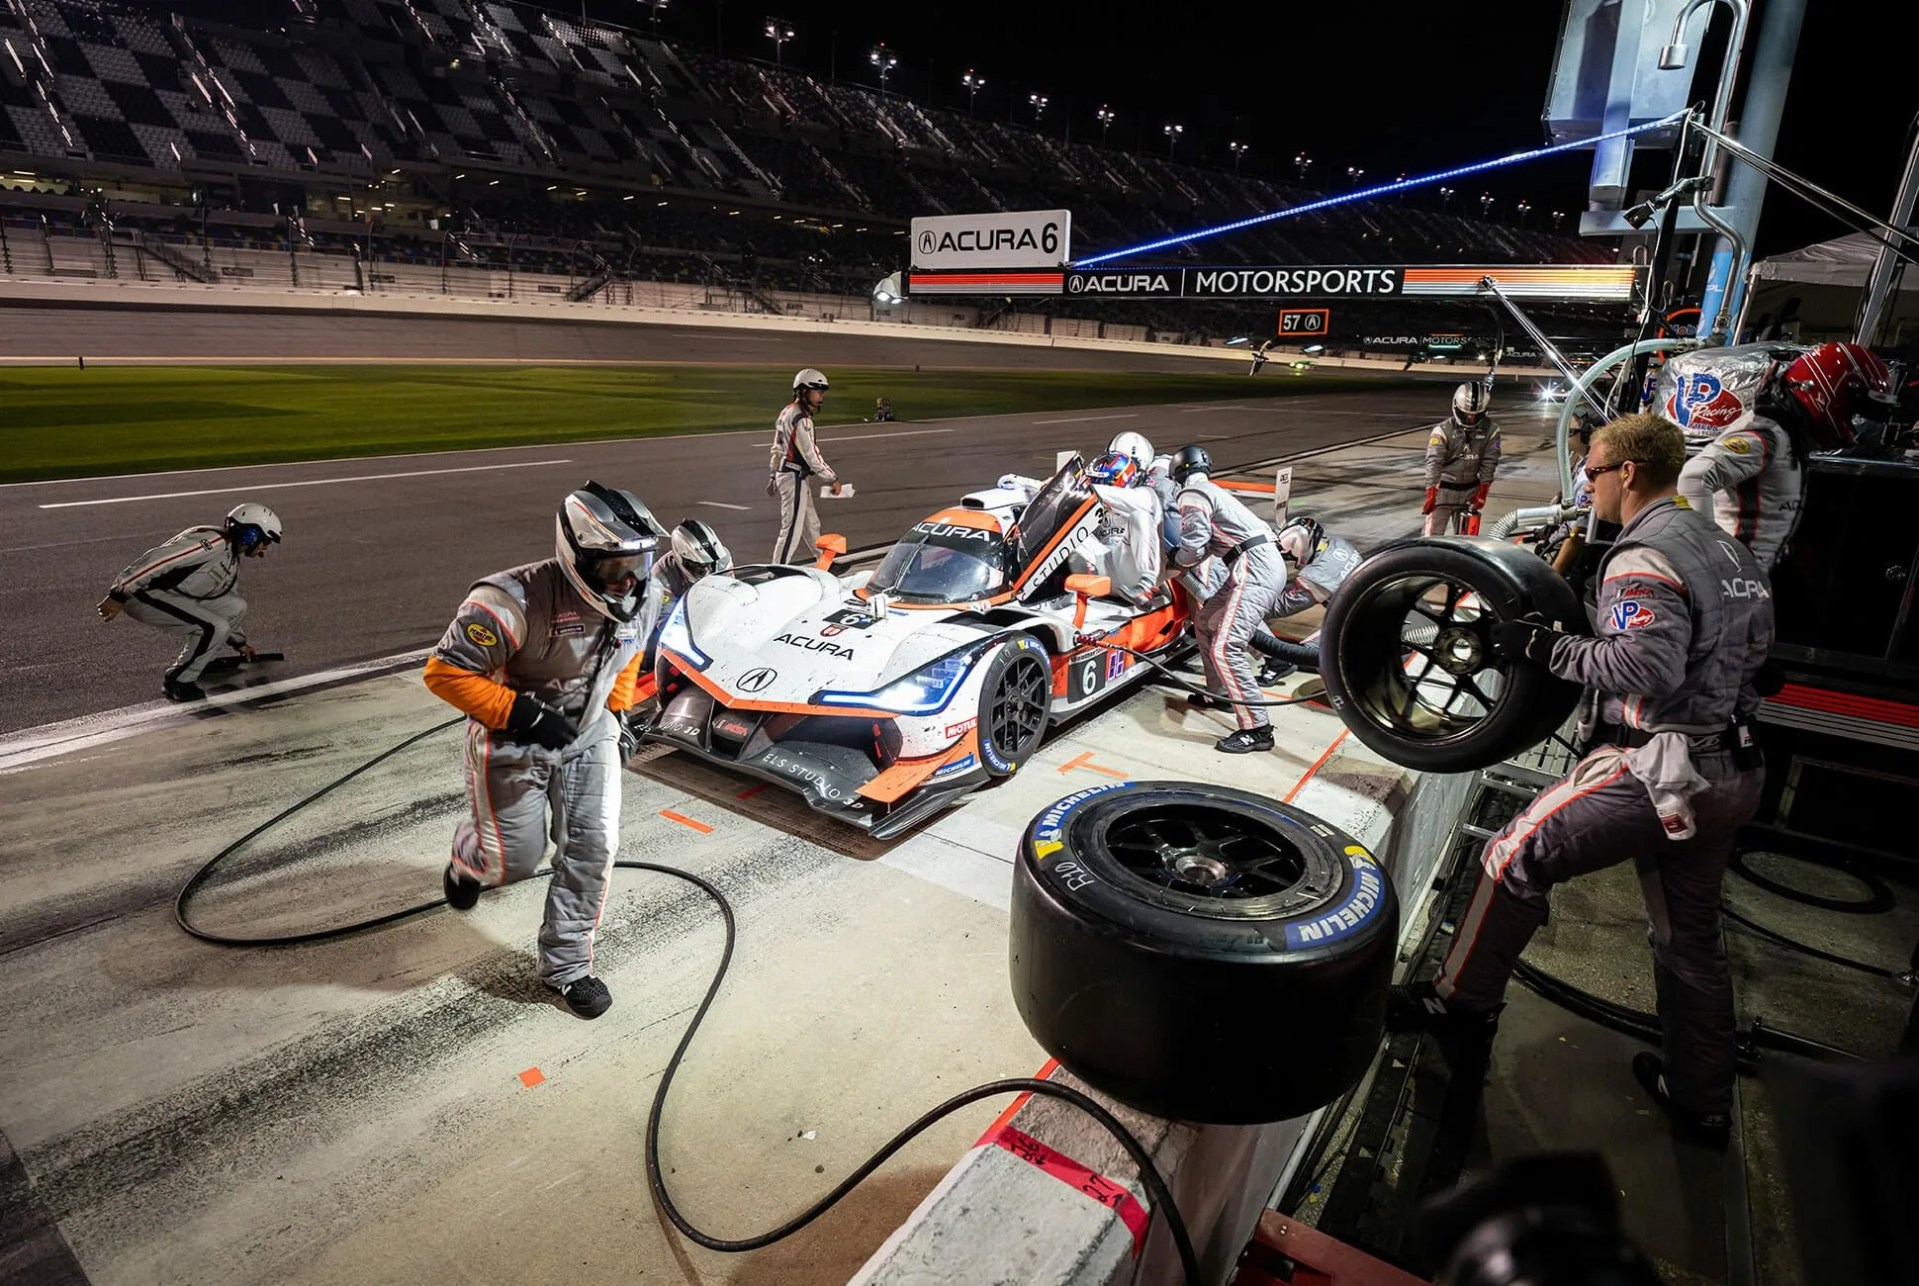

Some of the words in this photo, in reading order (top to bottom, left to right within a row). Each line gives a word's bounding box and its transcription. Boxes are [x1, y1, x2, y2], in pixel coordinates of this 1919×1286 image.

[938, 228, 1038, 252] ACURA
[1041, 222, 1059, 254] 6
[1084, 274, 1170, 292] ACURA
[1195, 269, 1396, 294] MOTORSPORTS
[1283, 314, 1301, 331] 57
[1372, 336, 1419, 345] ACURA
[1691, 403, 1742, 423] Racing
[911, 521, 990, 542] ACURA
[1612, 600, 1639, 630] VP
[772, 633, 855, 661] ACURA
[1083, 660, 1097, 695] 6
[762, 753, 788, 768] ELS
[788, 764, 841, 799] STUDIO
[935, 758, 972, 776] MICHELIN
[1054, 861, 1096, 892] R10
[1297, 871, 1381, 943] MICHELIN
[1082, 1174, 1115, 1203] 27
